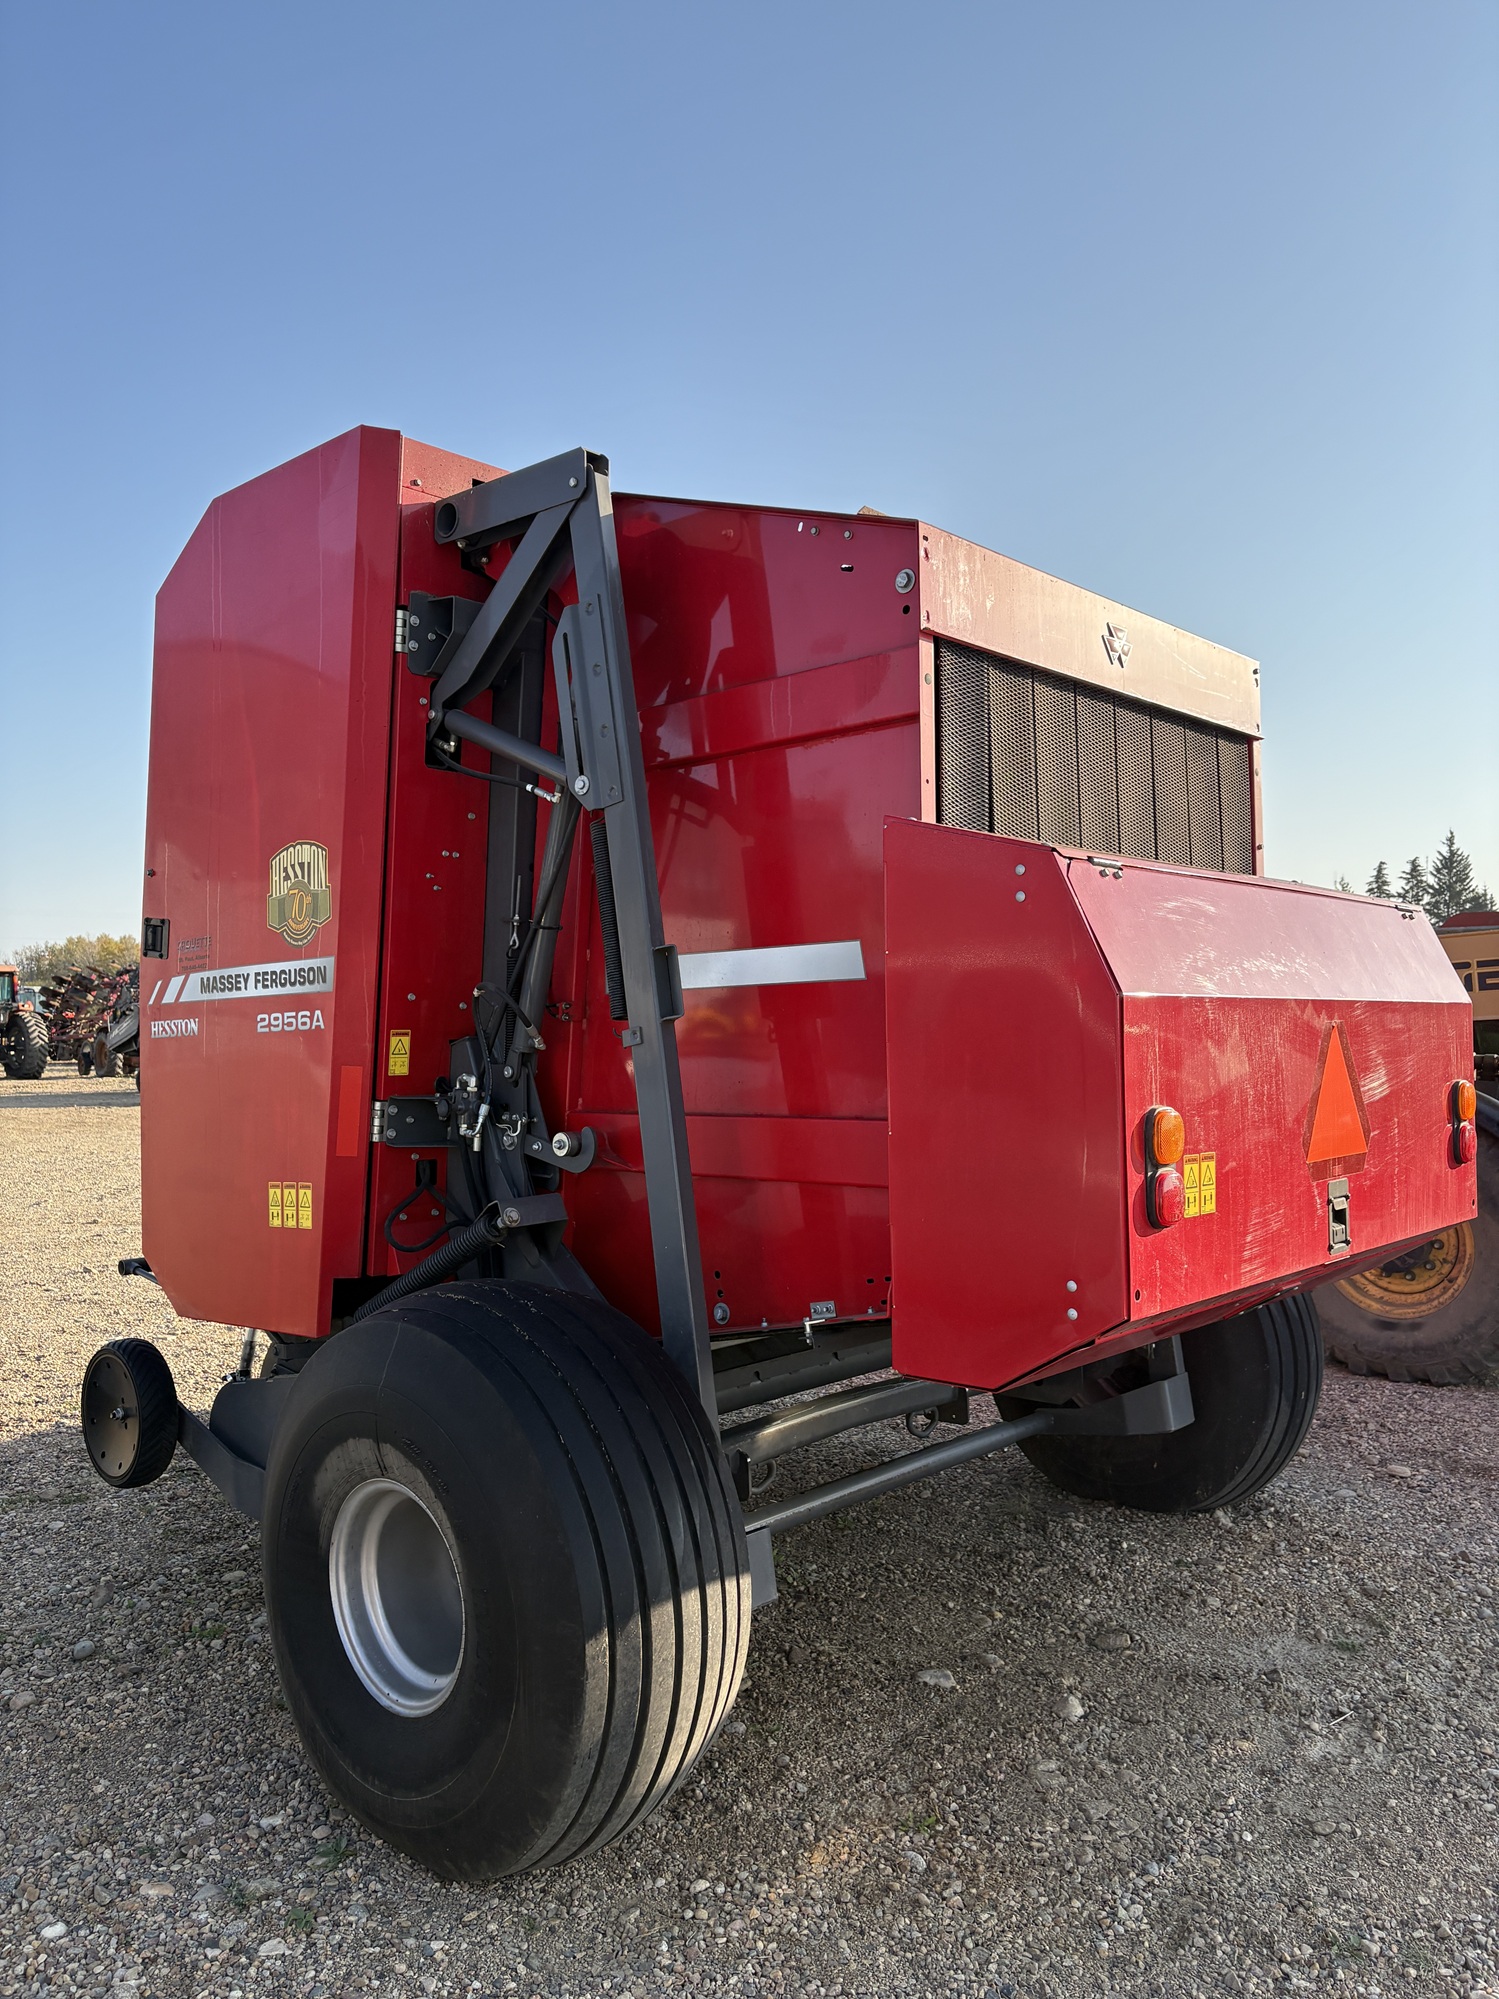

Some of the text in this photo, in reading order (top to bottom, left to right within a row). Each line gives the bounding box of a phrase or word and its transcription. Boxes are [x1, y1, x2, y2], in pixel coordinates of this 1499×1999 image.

[272, 844, 326, 898] HESSTON
[200, 965, 327, 995] MASSEY FERGUSON
[151, 1018, 199, 1039] HESSTON
[257, 1009, 325, 1033] 2956A
